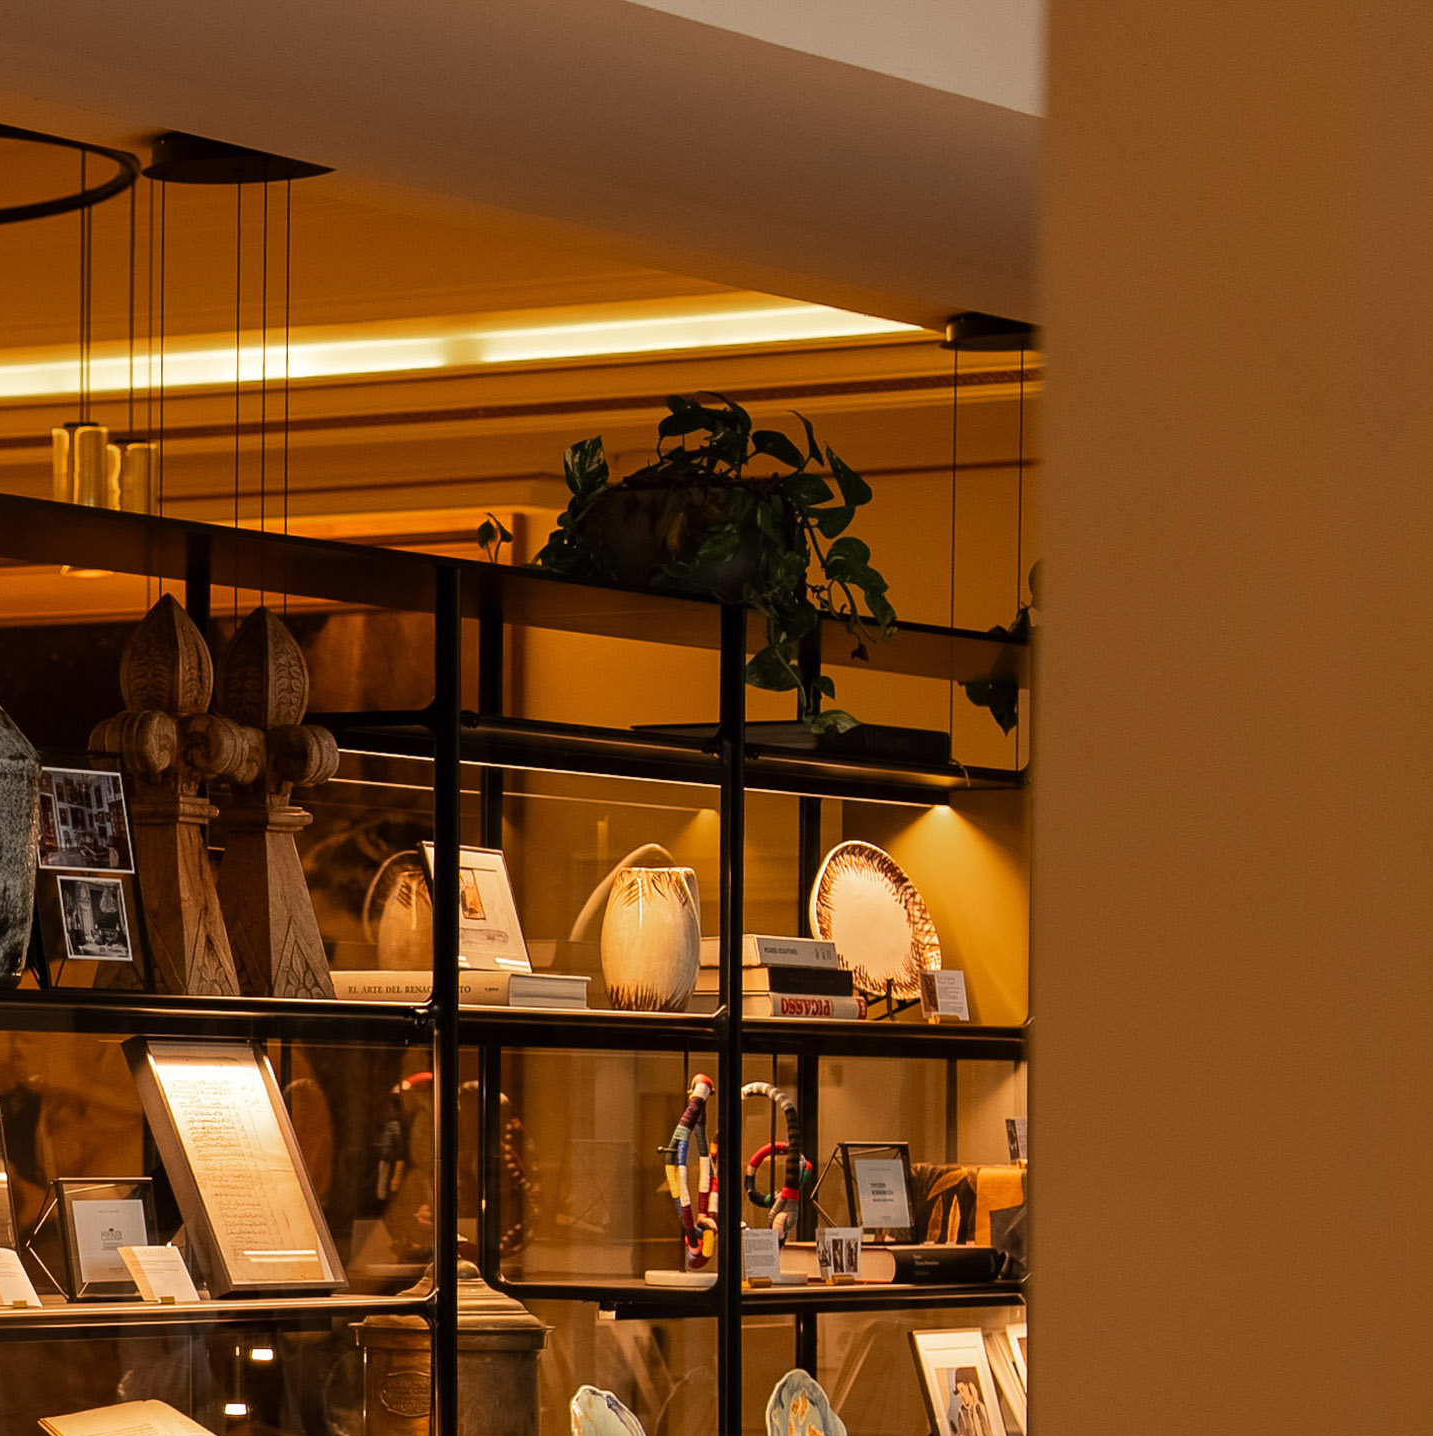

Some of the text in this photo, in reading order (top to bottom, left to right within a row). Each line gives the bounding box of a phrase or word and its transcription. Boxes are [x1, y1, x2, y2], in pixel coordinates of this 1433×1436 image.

[348, 985, 359, 994] EL
[361, 985, 383, 994] ARTE
[386, 985, 403, 994] DEL
[780, 997, 831, 1016] PICASSO
